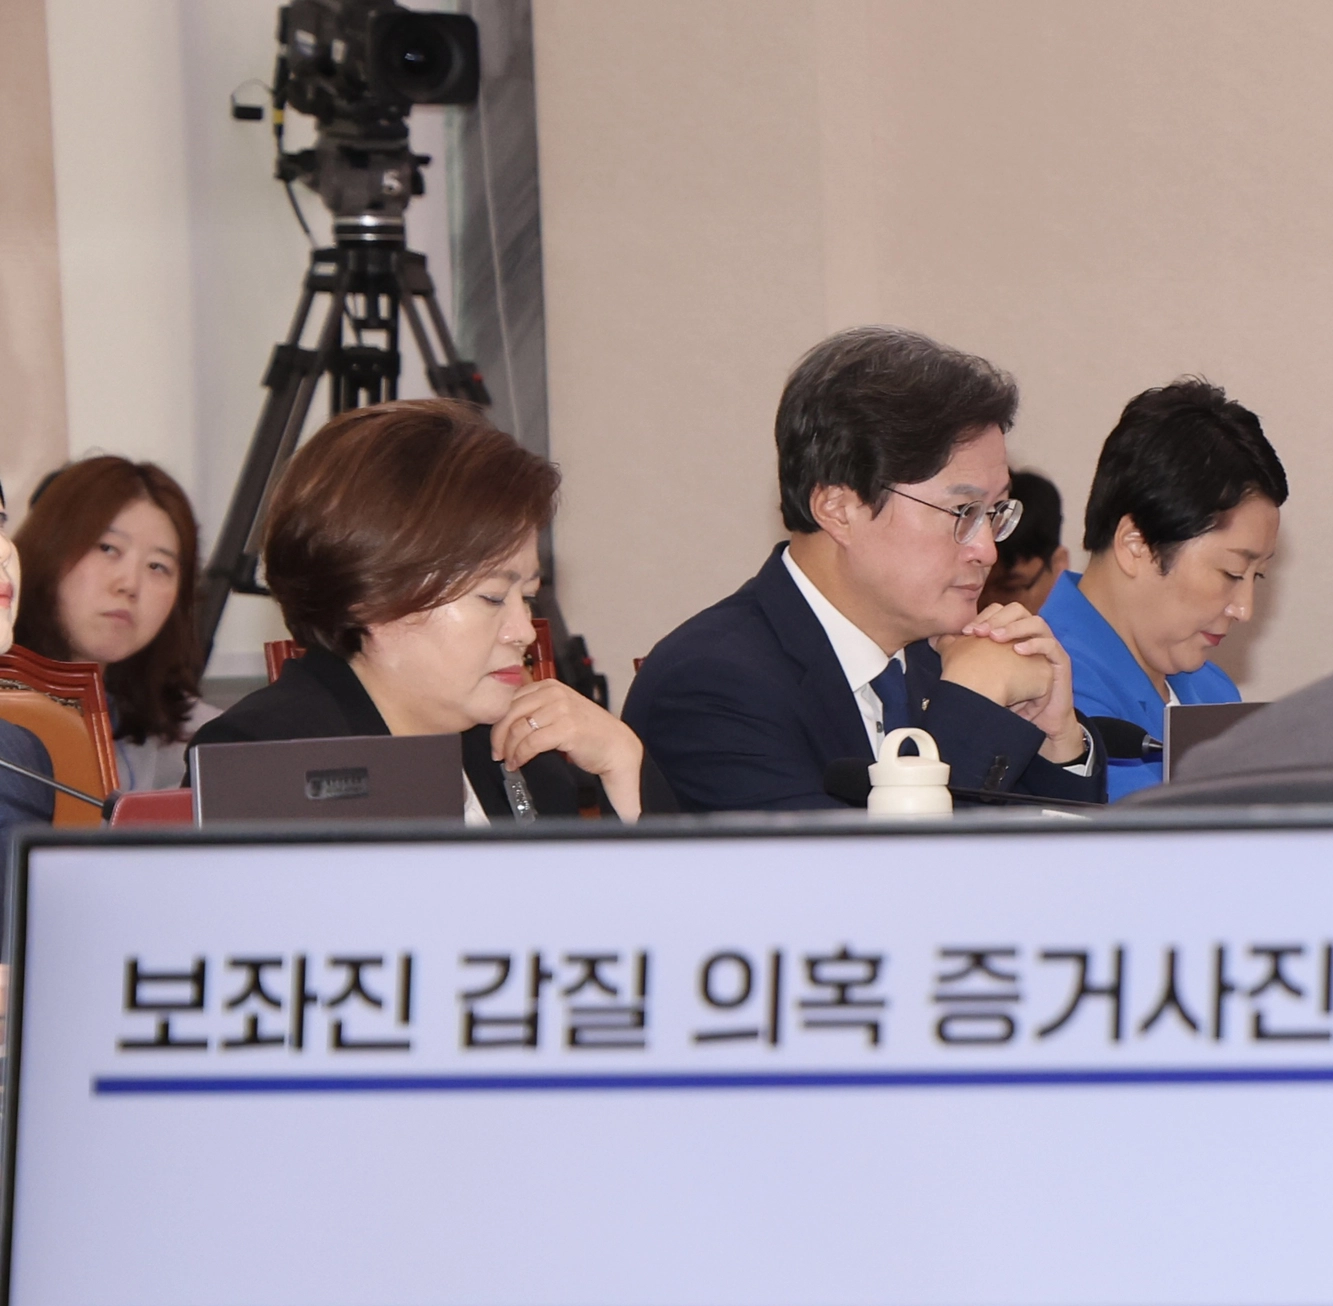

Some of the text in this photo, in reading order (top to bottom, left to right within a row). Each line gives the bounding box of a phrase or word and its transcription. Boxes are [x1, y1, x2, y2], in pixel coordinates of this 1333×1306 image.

[117, 952, 415, 1051] 보좌진
[458, 946, 652, 1050] 갑질
[690, 944, 888, 1049] 의혹
